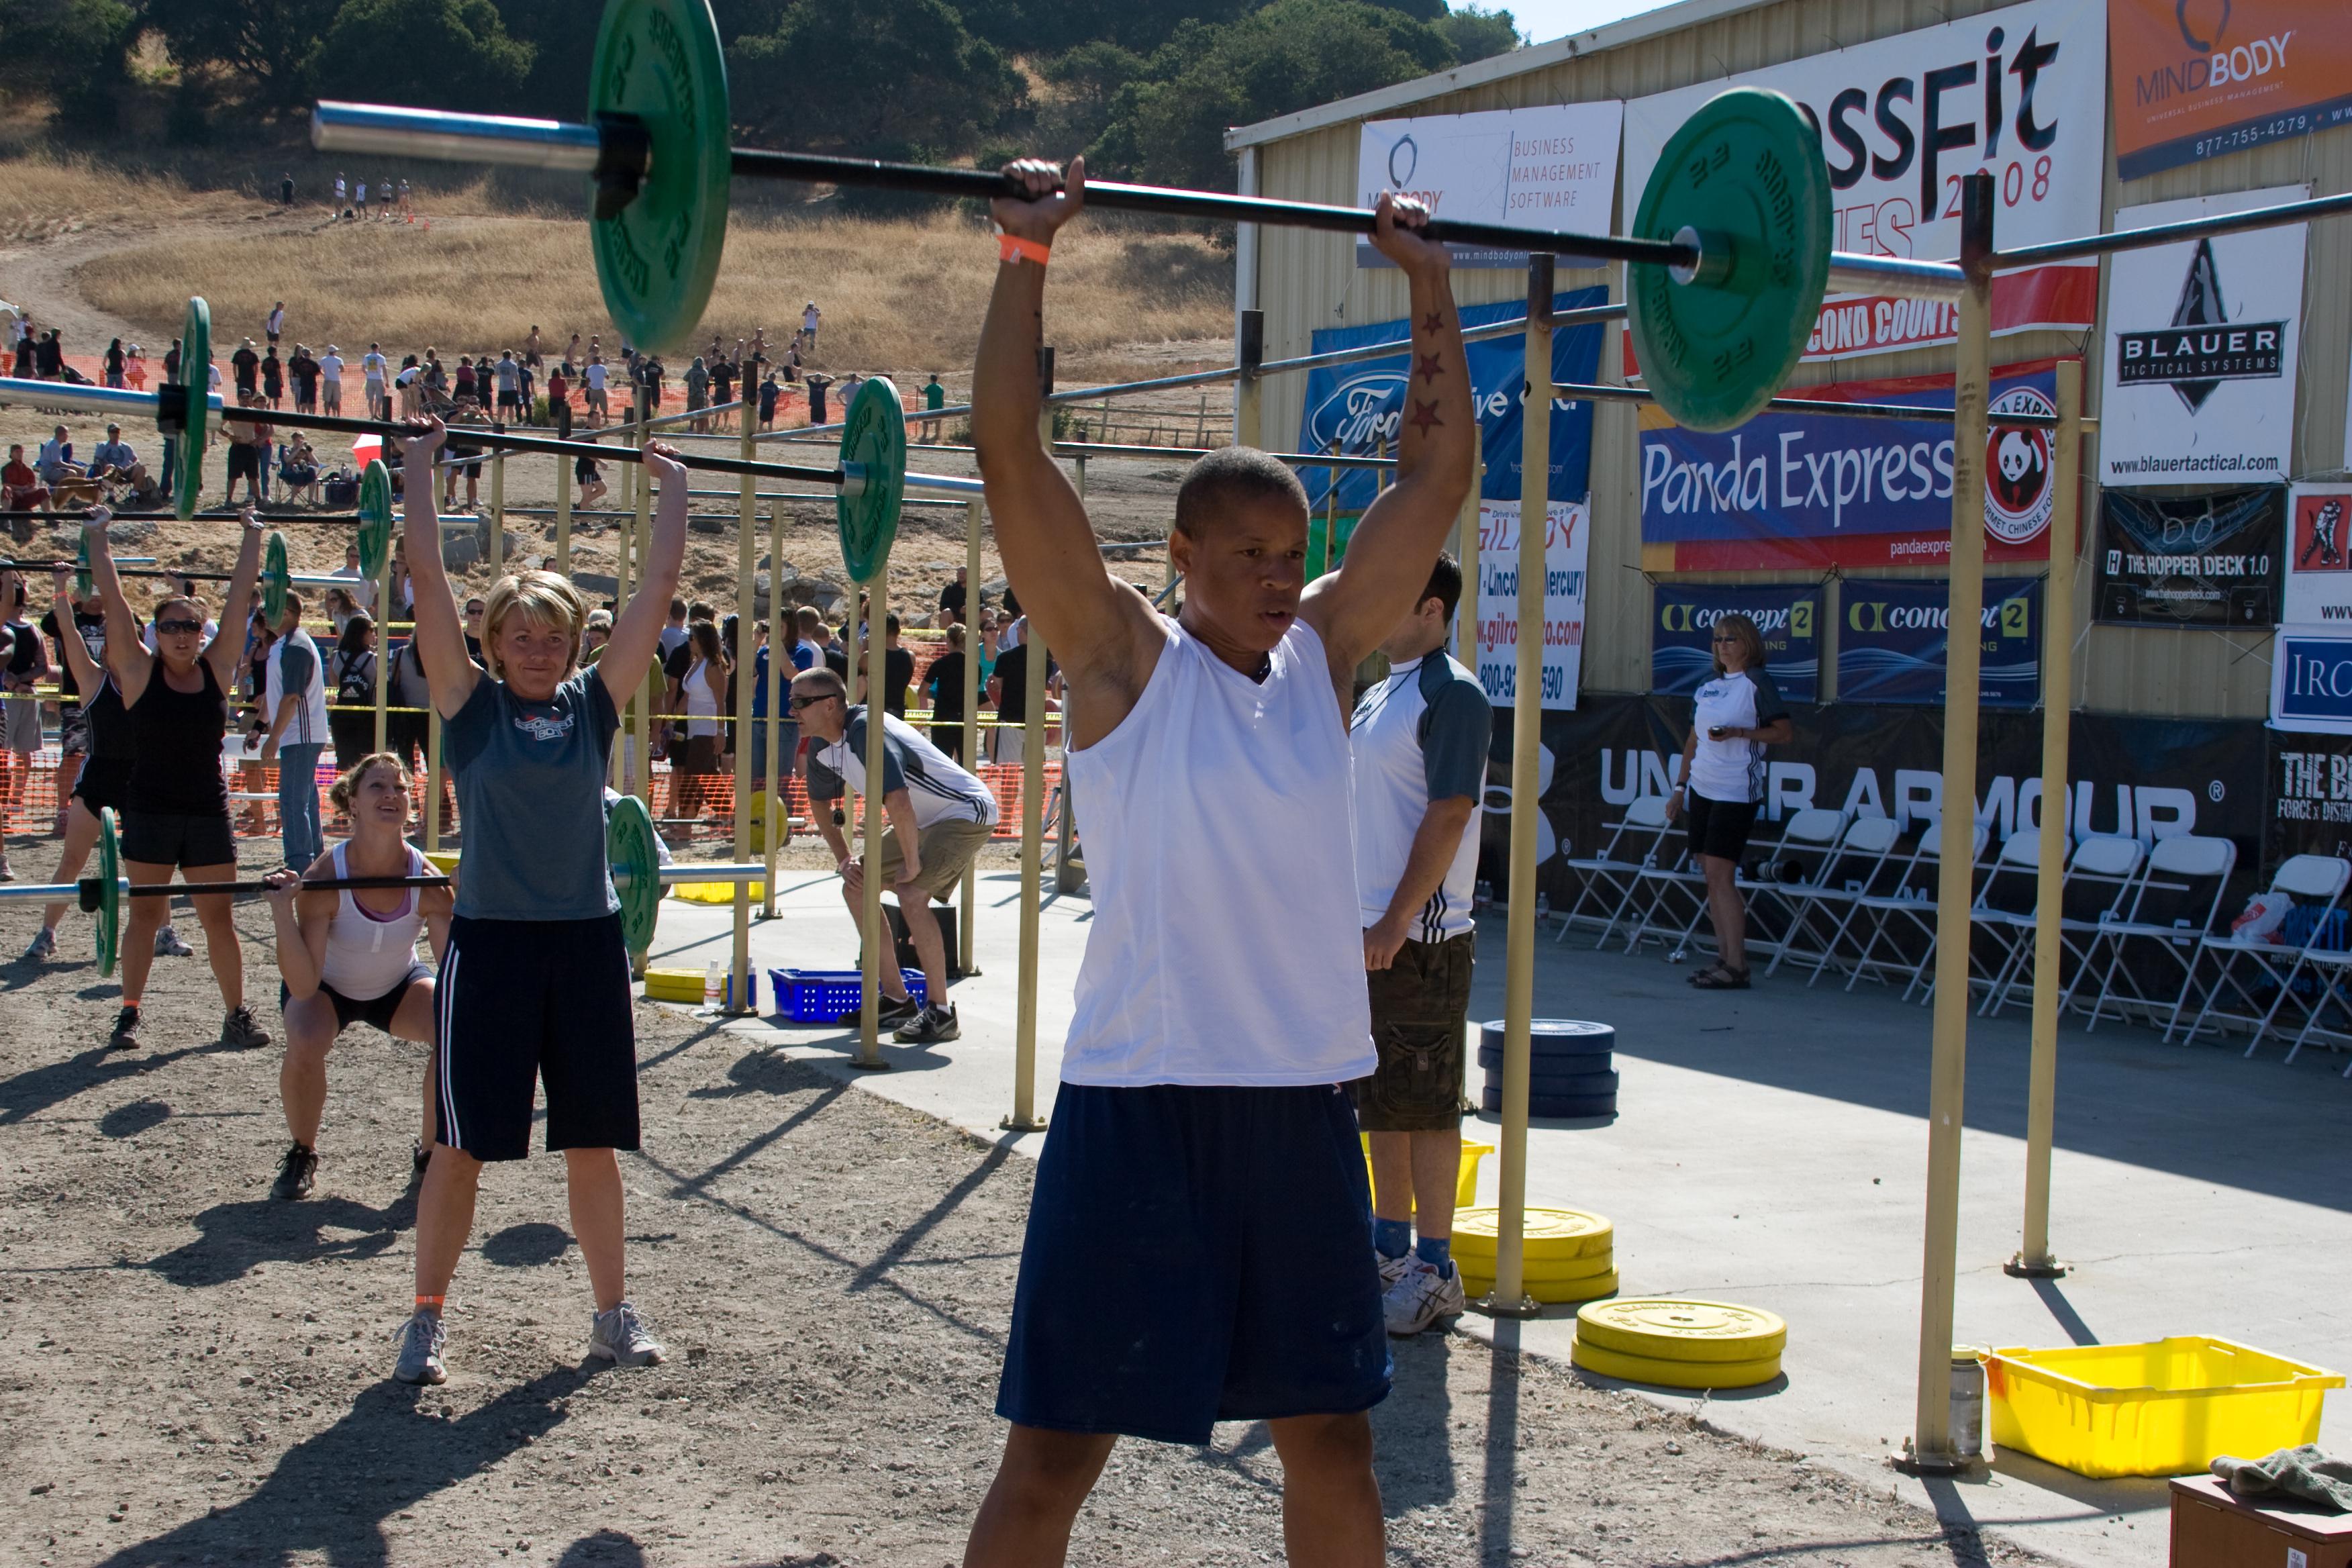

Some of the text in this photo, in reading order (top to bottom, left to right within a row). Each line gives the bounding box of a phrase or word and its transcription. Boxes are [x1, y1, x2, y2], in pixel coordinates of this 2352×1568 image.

[2137, 32, 2291, 107] MINDBODY
[2146, 81, 2285, 124] UNIVERSAL BUSINESS MANAGEMENT
[2196, 115, 2306, 155] 877-755-4279
[1514, 137, 1575, 157] BUSINESS
[1512, 162, 1601, 183] MANAGEMENT
[1942, 155, 2052, 219] 208
[1510, 191, 1577, 209] SOFTWARE
[1807, 305, 1869, 352] COND
[2125, 330, 2276, 359] BLAUER
[2124, 356, 2277, 377] TACTICAL SYSTEMS
[2111, 454, 2279, 474] www.blauertactical.com
[1642, 431, 1955, 528] Panda Express
[1479, 507, 1579, 551] GILOY
[2008, 512, 2043, 535] CHINESE
[2126, 554, 2146, 573] THE
[2149, 556, 2202, 575] HOPPER
[2203, 556, 2246, 575] DECK
[2249, 555, 2269, 575] 1.0
[1794, 607, 1809, 630] 2
[2006, 605, 2023, 629] 2
[1765, 641, 1787, 651] ING
[2280, 751, 2326, 799] THE
[2277, 798, 2312, 820] FORCE
